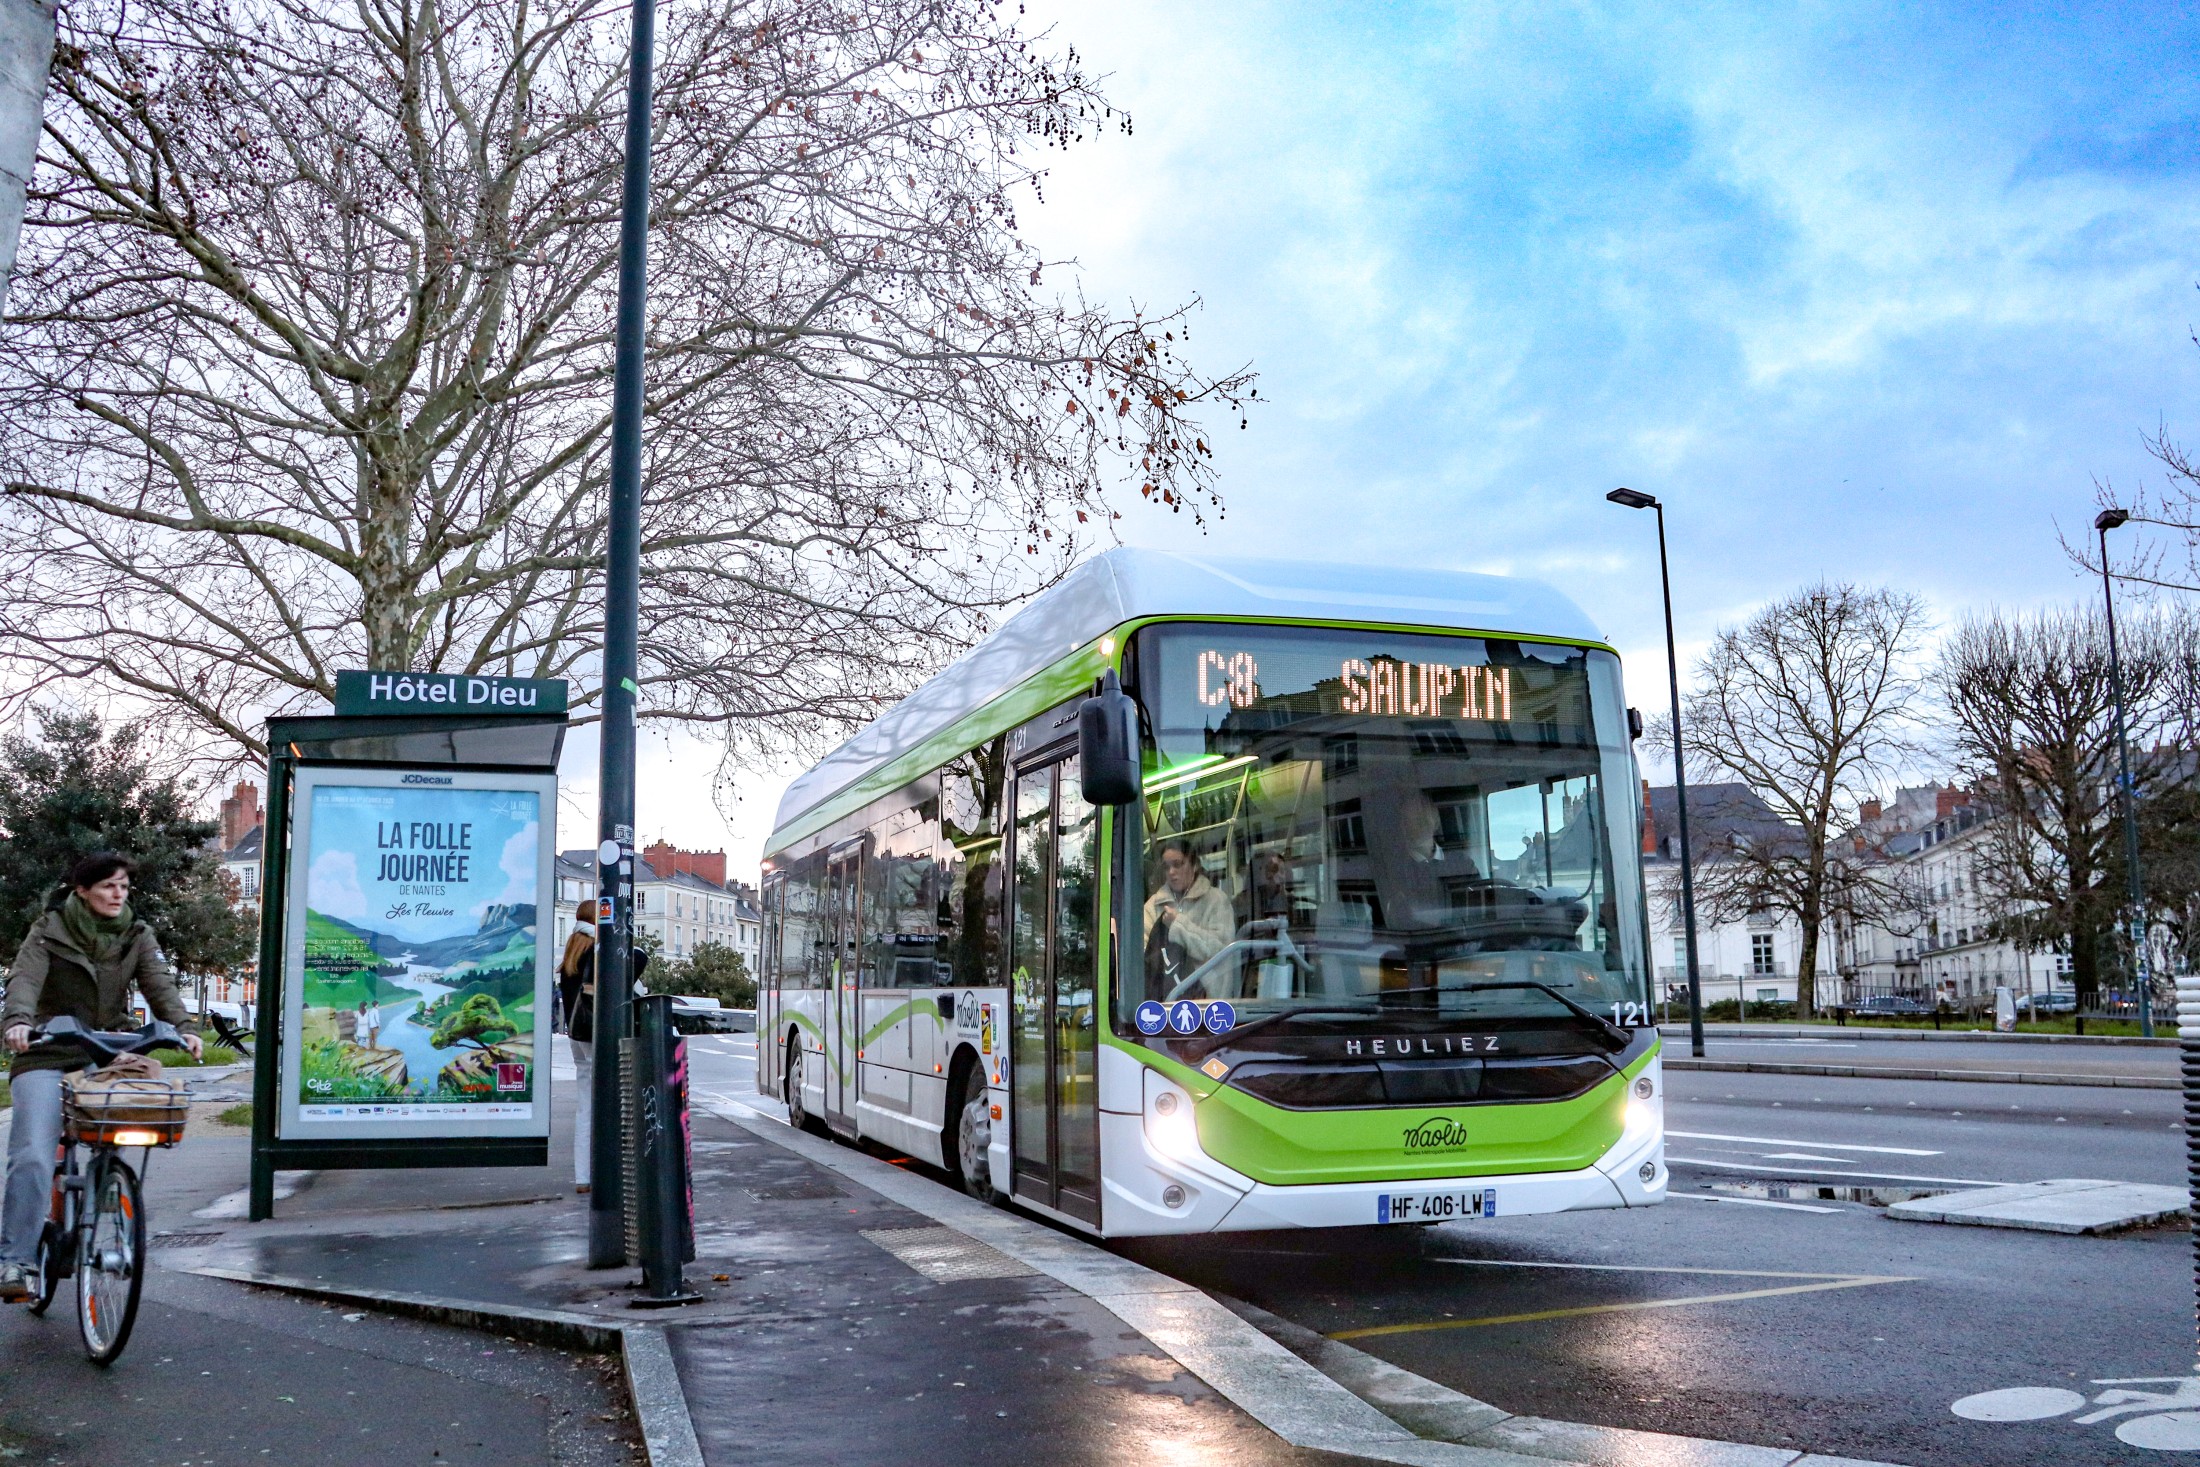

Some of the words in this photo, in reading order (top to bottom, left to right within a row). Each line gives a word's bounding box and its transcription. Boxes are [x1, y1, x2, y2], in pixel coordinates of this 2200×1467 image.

[370, 674, 457, 703] Hôtel
[467, 679, 537, 706] Dieu
[1198, 650, 1258, 707] C8
[1342, 659, 1511, 720] SAUPIN
[1013, 726, 1027, 753] 121
[401, 774, 453, 785] JCDecaux
[378, 821, 403, 849] LA
[410, 822, 472, 850] FOLLE
[377, 851, 470, 883] JOURNÉE
[399, 884, 411, 896] DE
[412, 885, 446, 896] NANTES
[386, 902, 411, 920] Les
[415, 903, 455, 917] Fleuves
[1610, 1001, 1650, 1028] 121
[1346, 1035, 1500, 1055] HEULIEZ
[307, 1078, 332, 1094] Cité
[1392, 1193, 1483, 1218] HF-406-LW
[1485, 1202, 1495, 1214] 44
